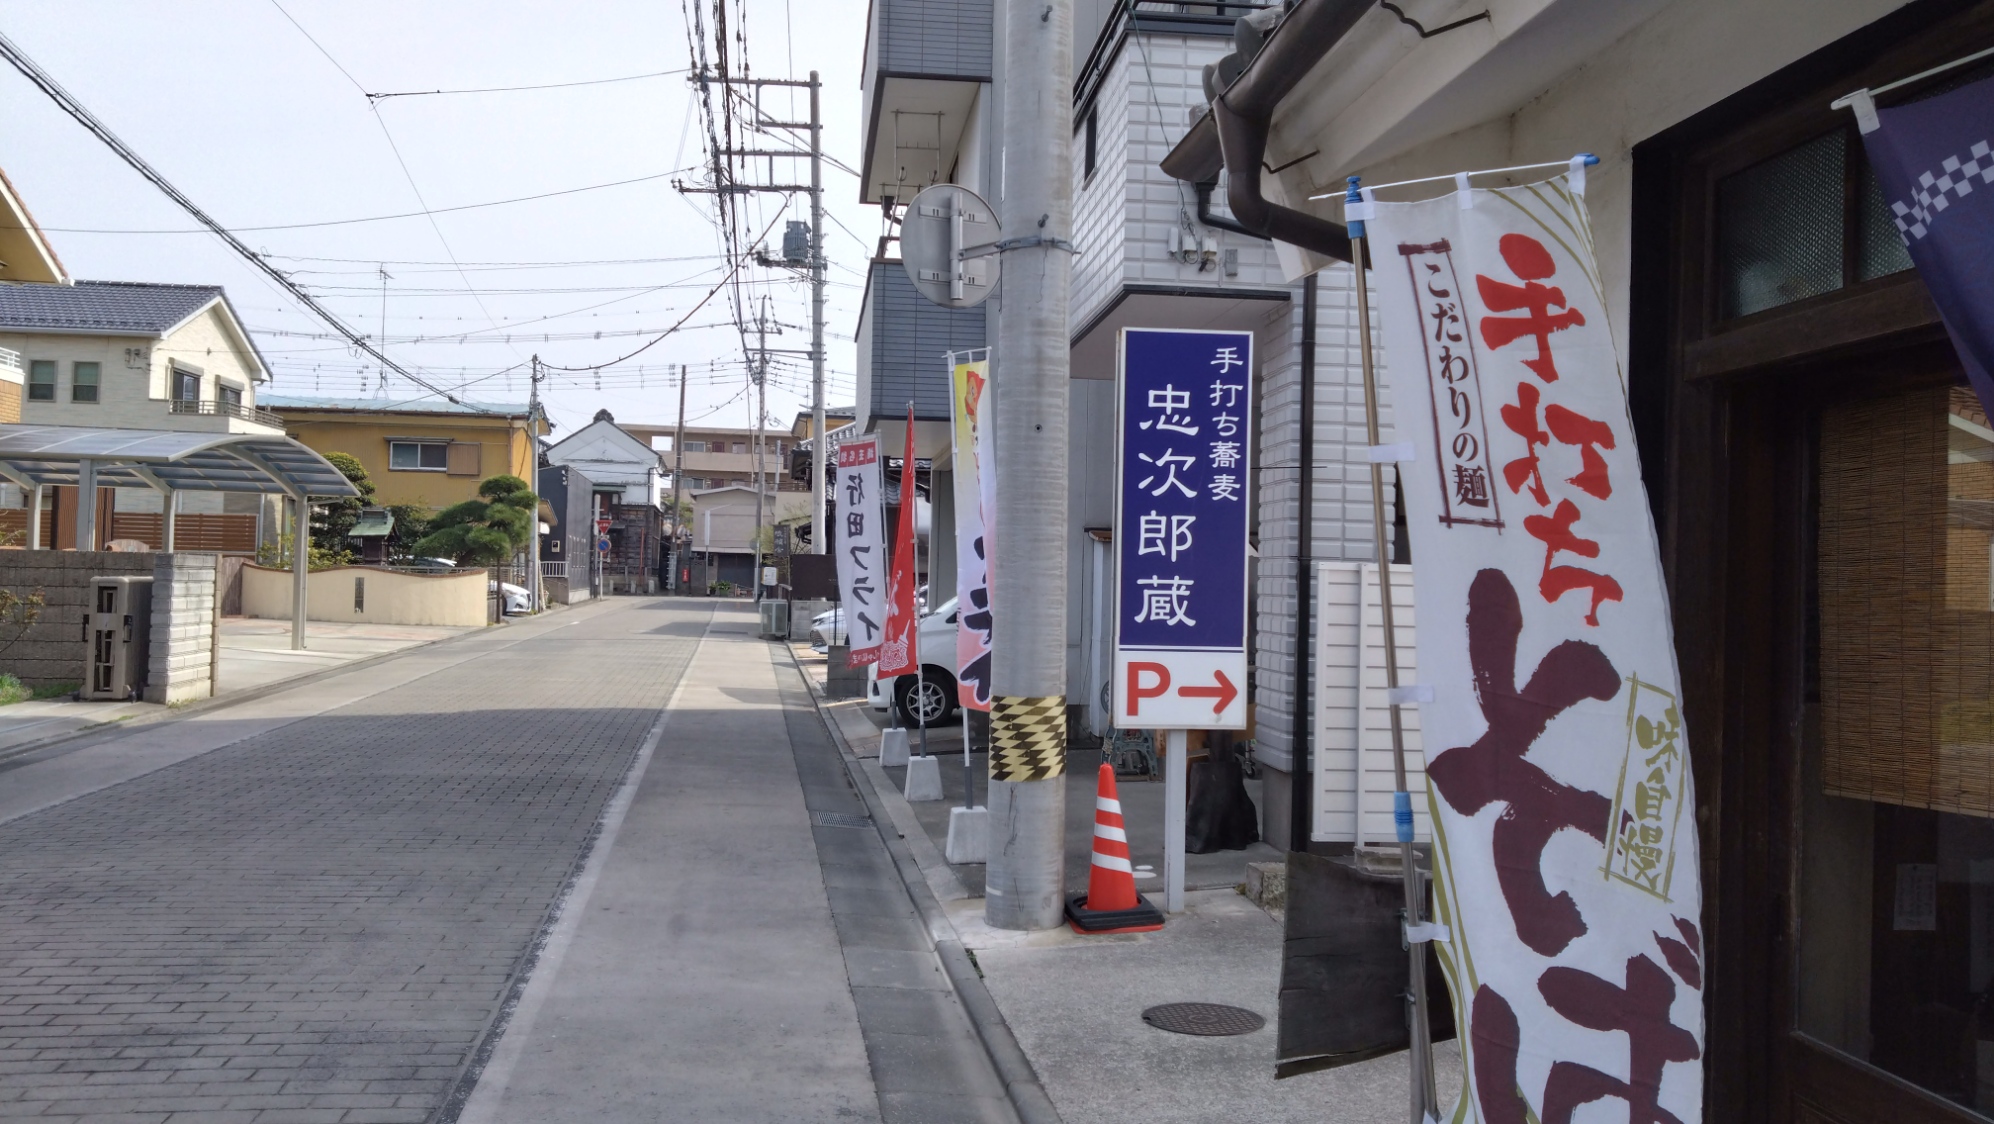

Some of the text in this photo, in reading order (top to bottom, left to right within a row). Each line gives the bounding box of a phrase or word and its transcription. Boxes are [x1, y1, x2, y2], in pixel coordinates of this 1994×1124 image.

[1208, 346, 1244, 502] 手打ち蕎麦
[1424, 261, 1491, 509] こだわりの麺
[1475, 232, 1624, 627] 手打ち
[1133, 383, 1200, 627] 忠次郎蔵
[1126, 661, 1172, 717] P
[1617, 700, 1682, 891] 味自慢
